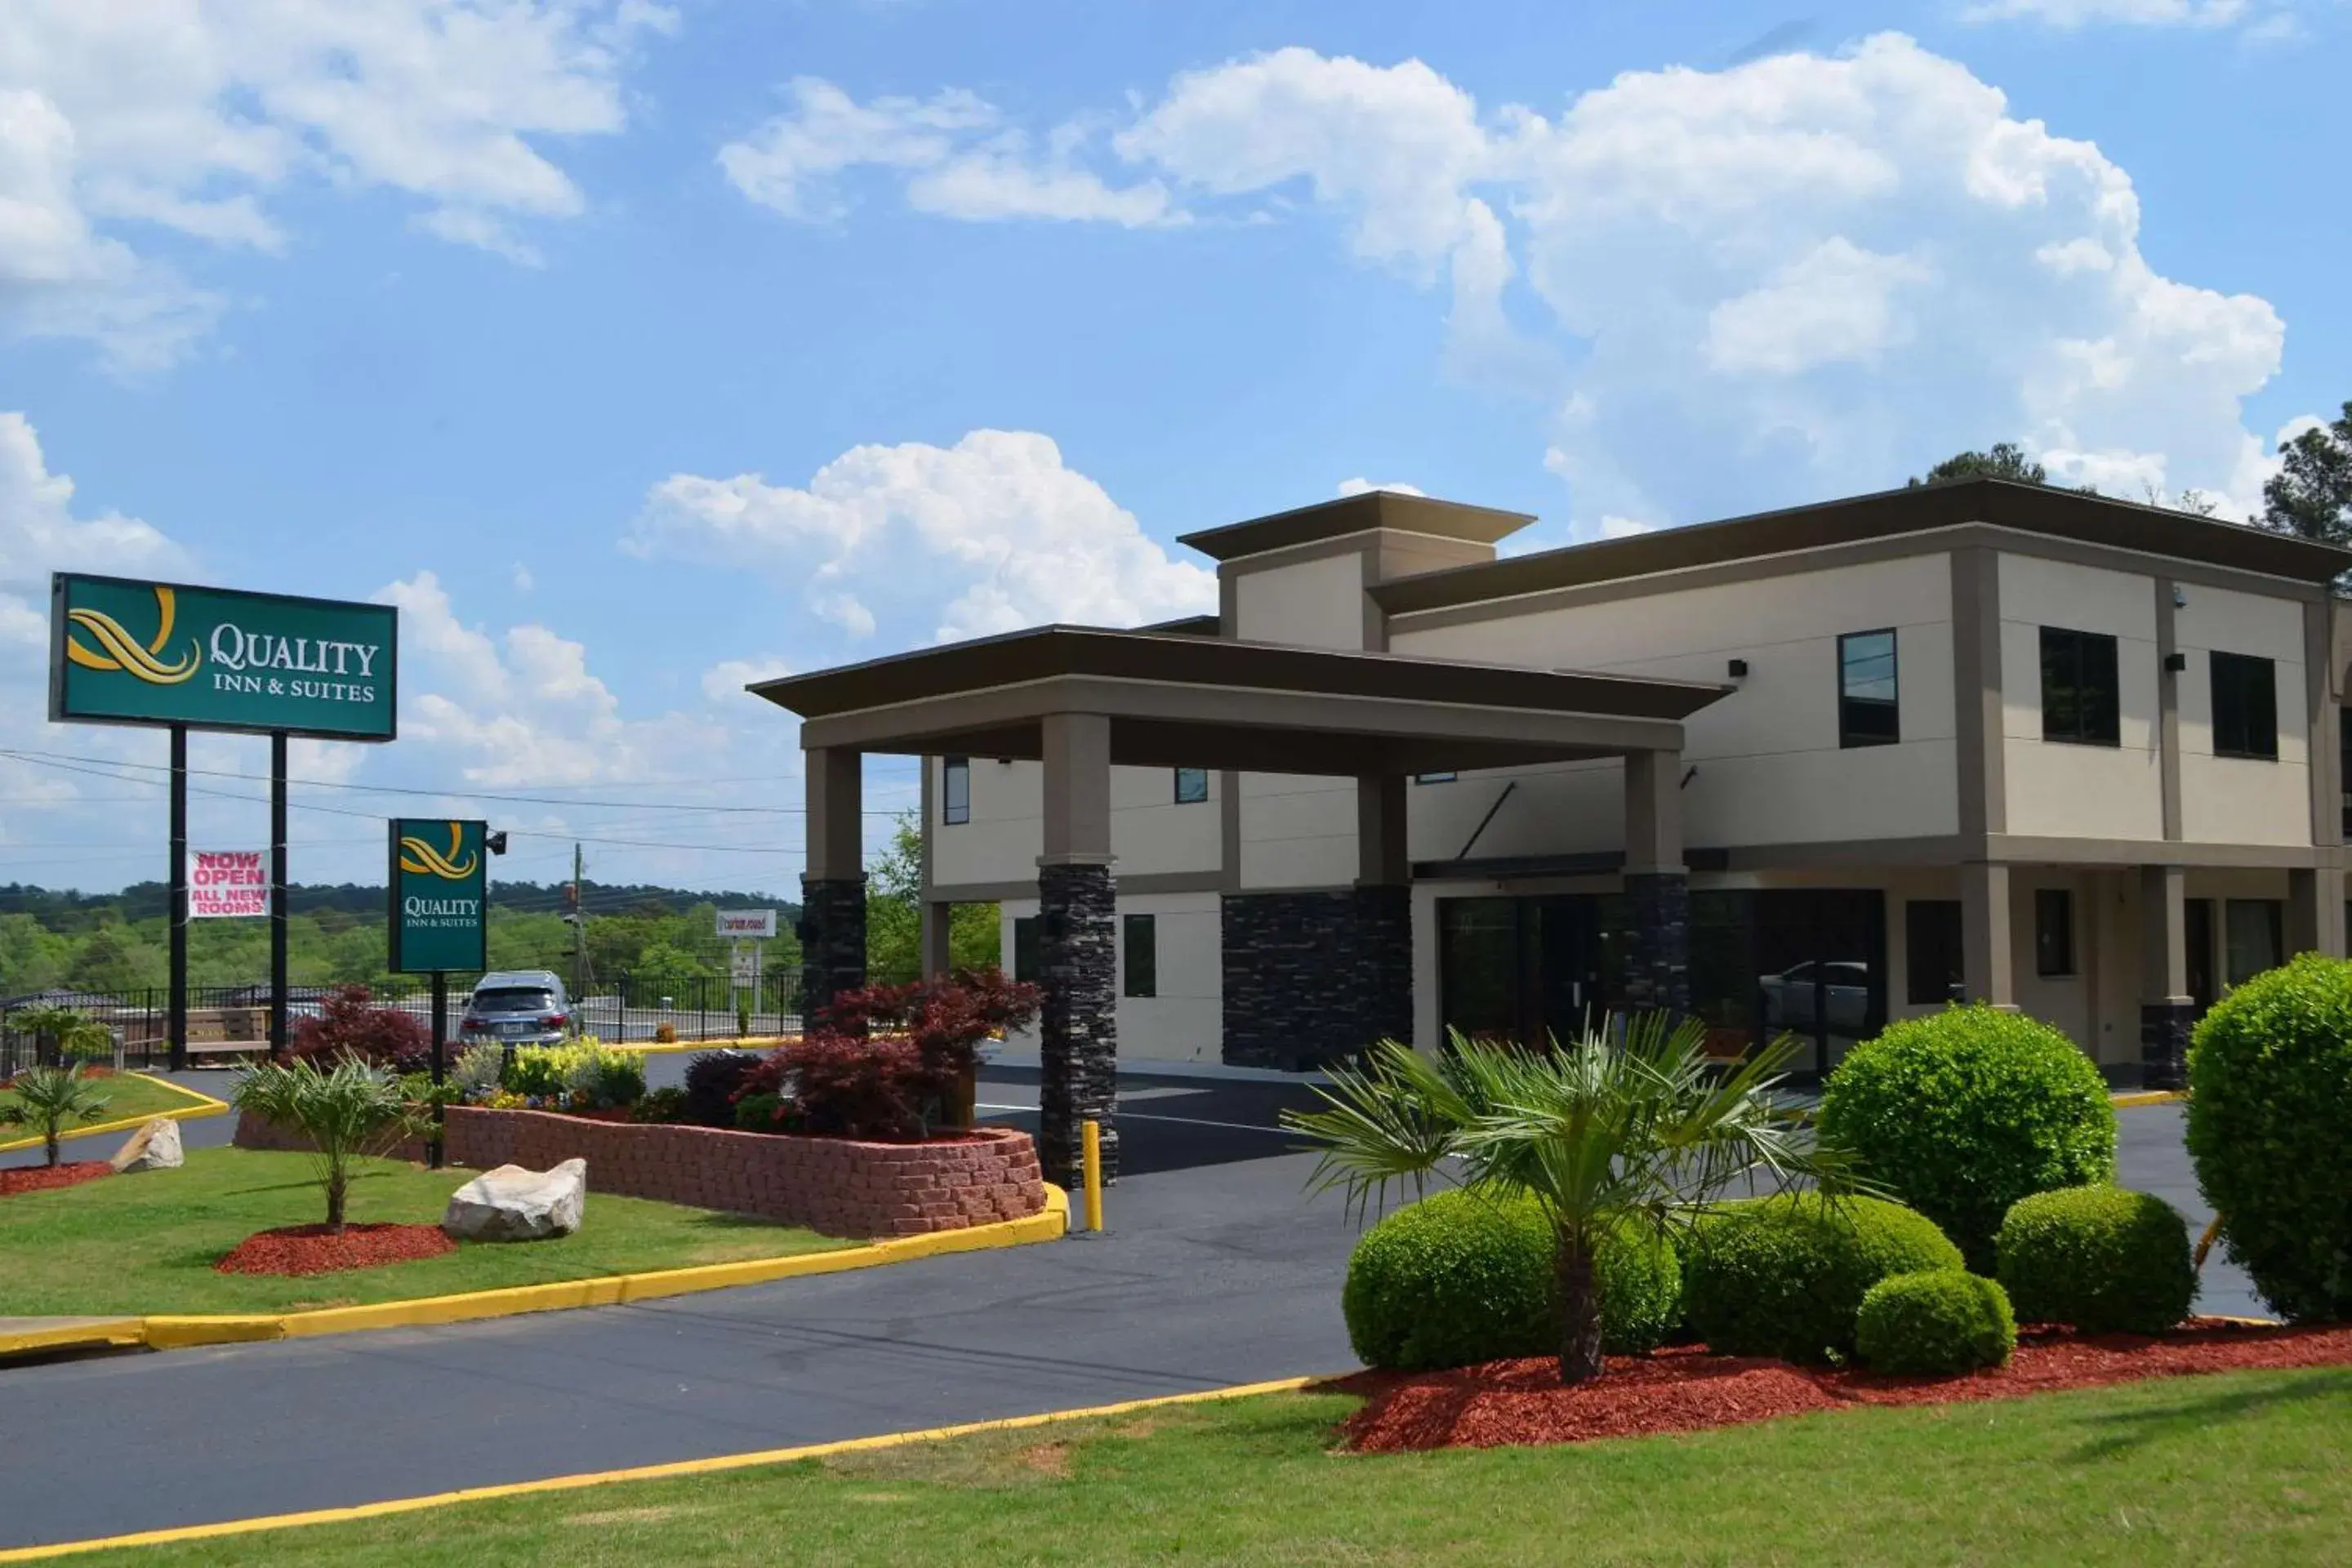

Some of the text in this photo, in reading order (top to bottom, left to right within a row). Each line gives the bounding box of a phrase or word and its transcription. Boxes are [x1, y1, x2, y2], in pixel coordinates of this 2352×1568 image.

[210, 622, 380, 677] QUALITY
[213, 673, 375, 703] INN & SUITES
[198, 852, 261, 869] NOW
[194, 870, 265, 885] OPEN
[192, 889, 267, 902] ALL NEW
[198, 902, 264, 914] ROOMS
[404, 896, 479, 917] QUALITY
[407, 918, 478, 928] INN & SUITES
